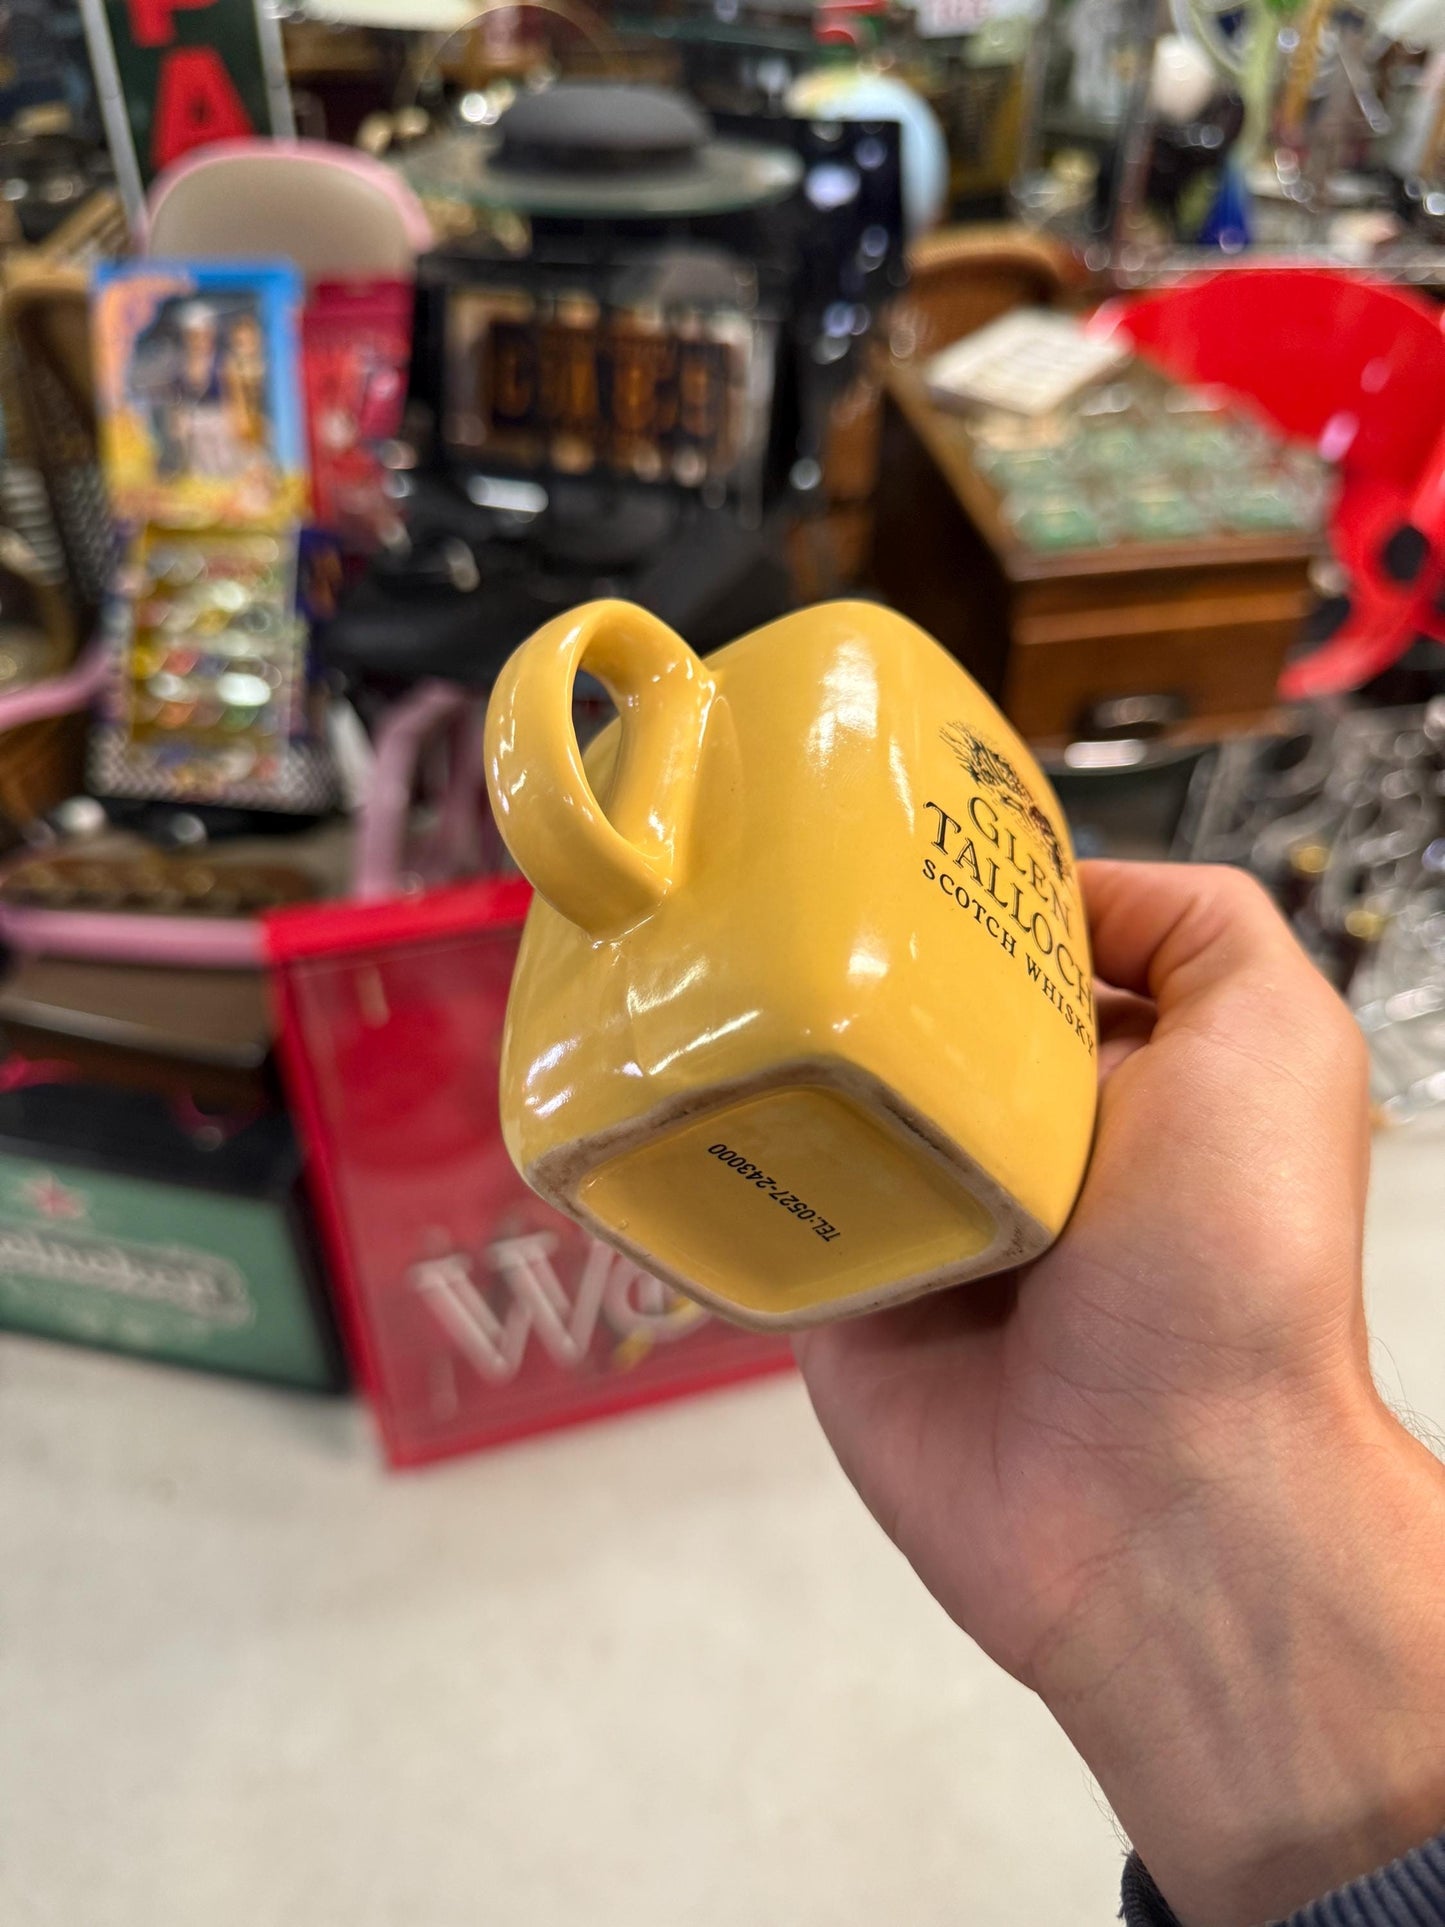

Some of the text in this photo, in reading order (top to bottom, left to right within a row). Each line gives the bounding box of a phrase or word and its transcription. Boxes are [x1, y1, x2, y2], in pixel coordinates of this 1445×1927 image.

[922, 800, 1094, 1027] TALLOCH
[922, 858, 1095, 1057] SCOTCH WHISKY
[966, 795, 1072, 940] GLEN
